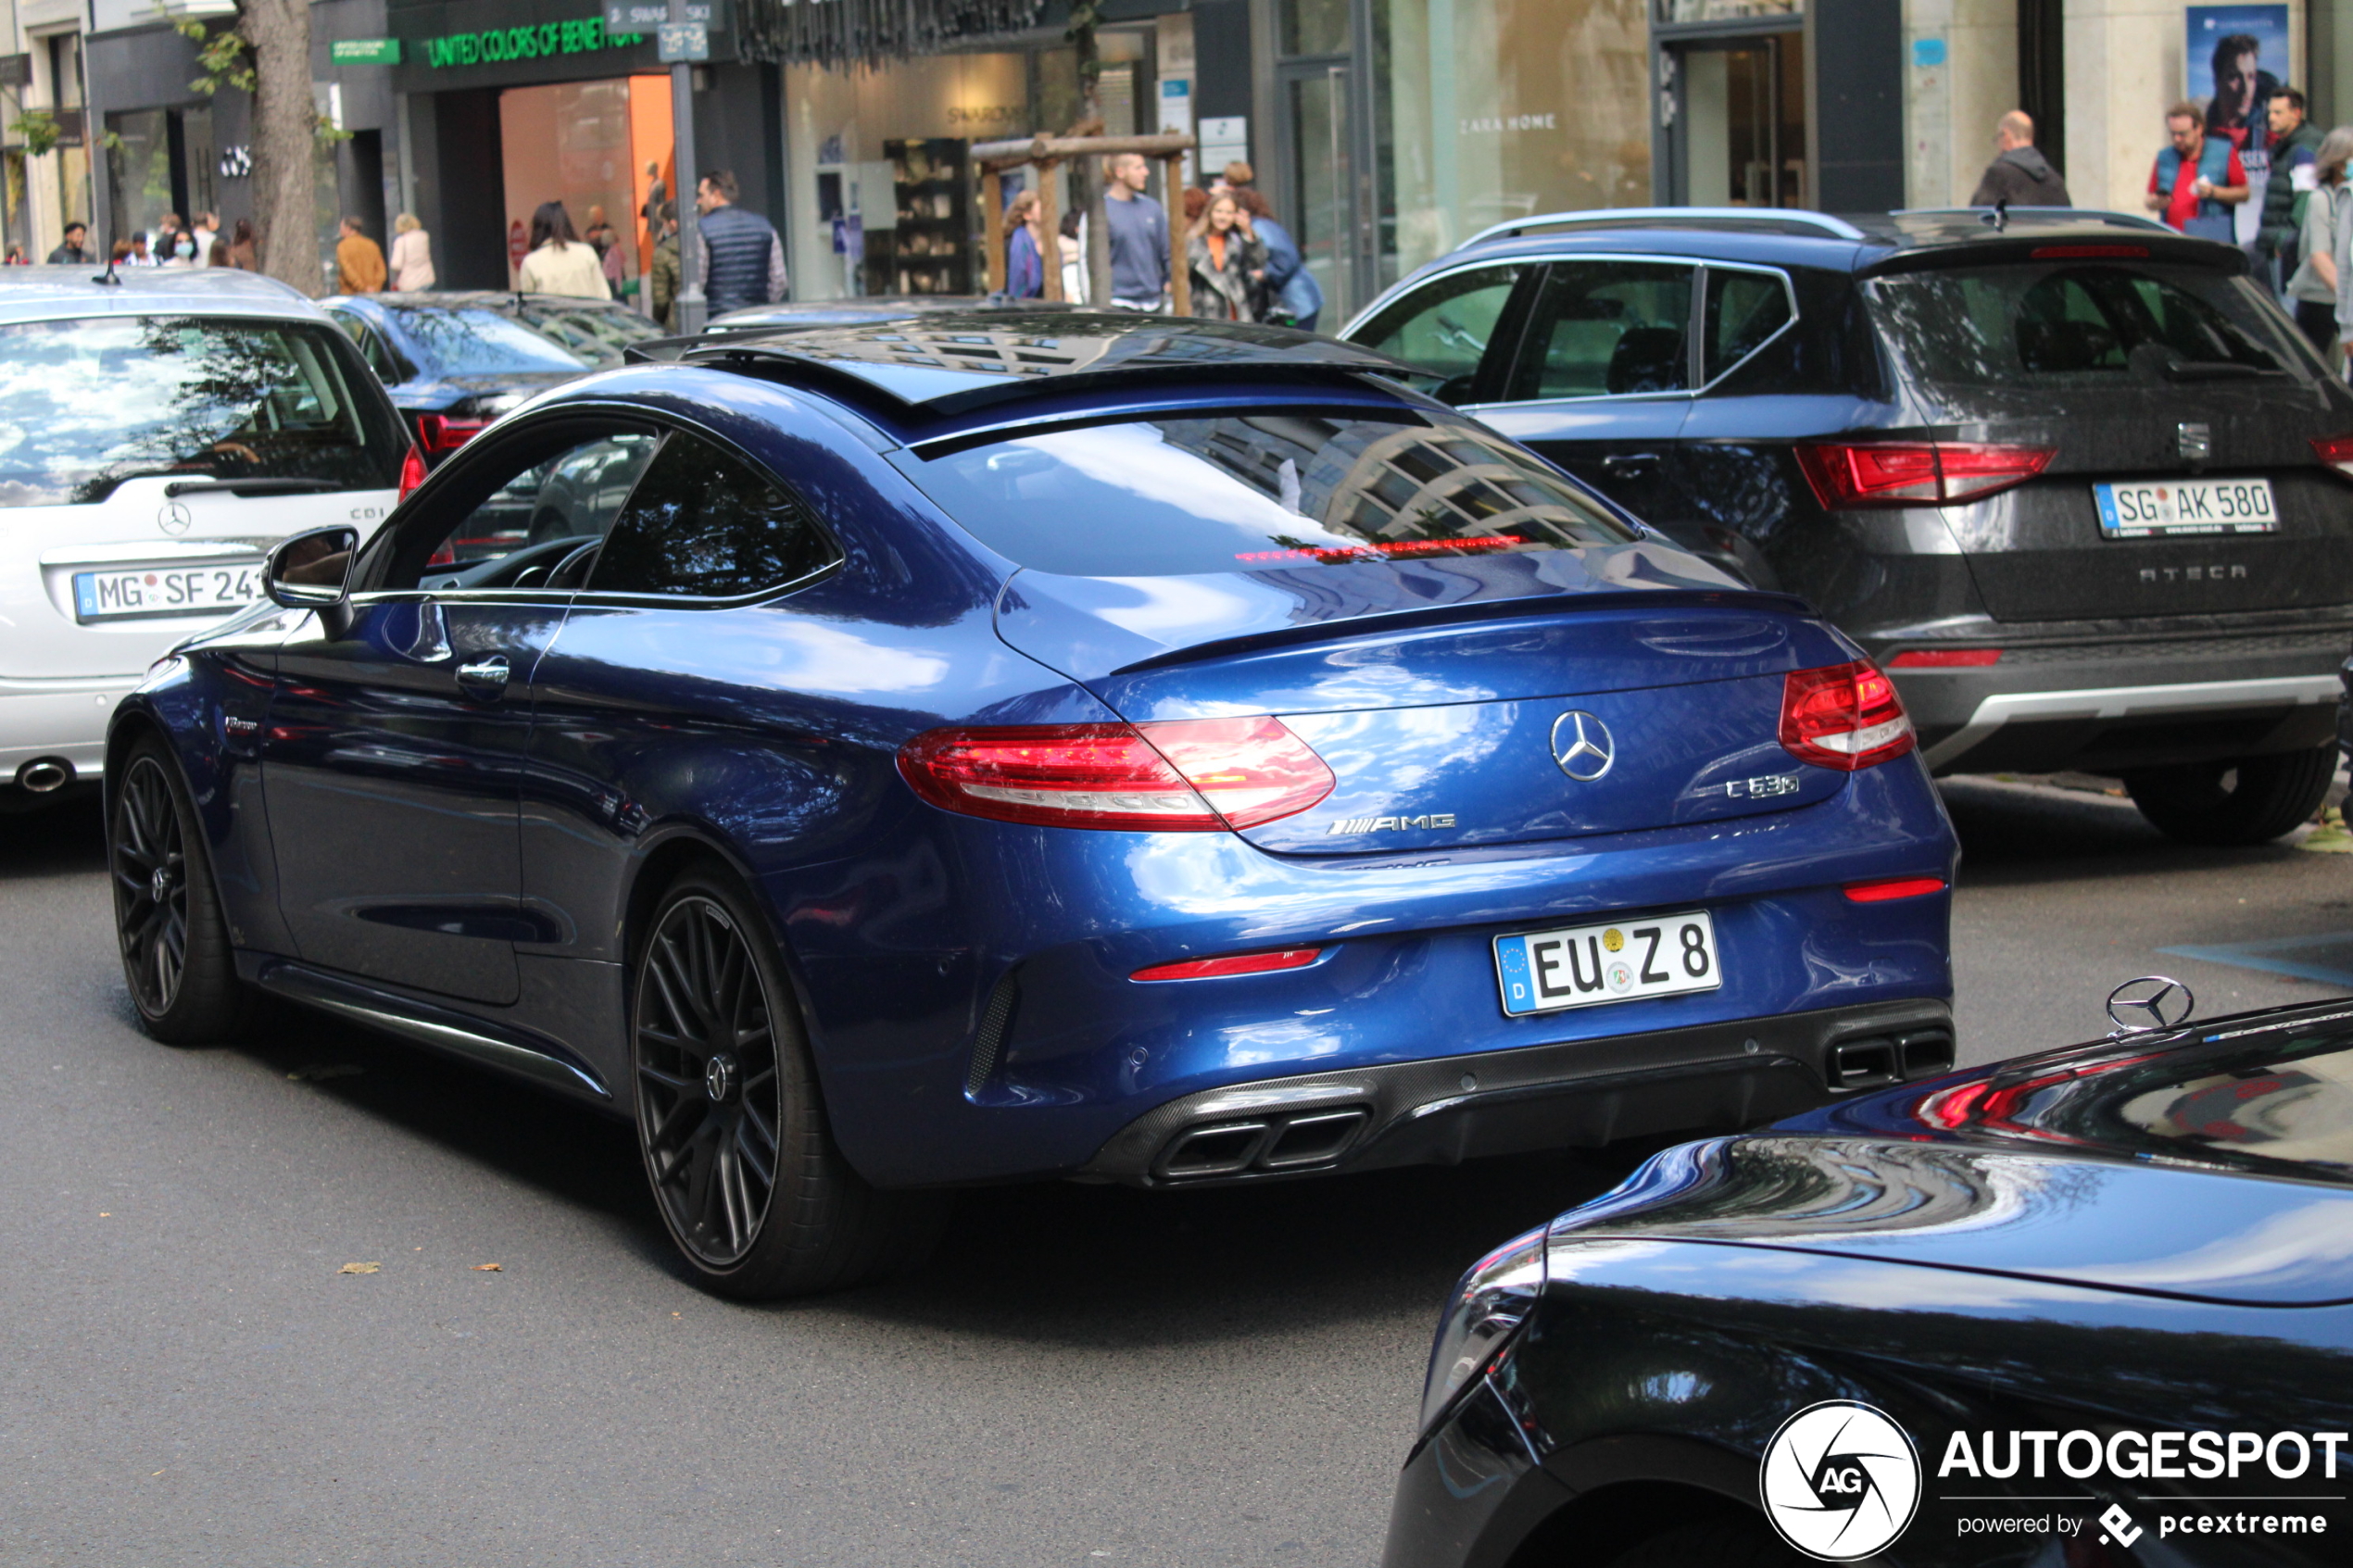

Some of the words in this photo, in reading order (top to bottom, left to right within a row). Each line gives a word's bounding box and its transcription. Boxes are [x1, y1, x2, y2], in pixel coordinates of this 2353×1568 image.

[429, 32, 479, 68] UNITED
[481, 25, 538, 62] COLORS
[538, 21, 560, 56] OF
[1459, 118, 1504, 134] ZARA
[1506, 113, 1555, 131] HOME
[350, 507, 384, 520] CDI
[2105, 510, 2114, 521] D
[2119, 490, 2158, 521] SG
[2178, 487, 2213, 519] AK
[2216, 485, 2271, 517] 580
[84, 598, 93, 609] D
[98, 576, 143, 608] MG
[165, 572, 204, 603] SF
[2139, 565, 2246, 583] ATECA
[1512, 983, 1526, 1000] D
[1533, 935, 1604, 998] EU
[1633, 927, 1669, 985] Z
[1680, 923, 1709, 978] 8
